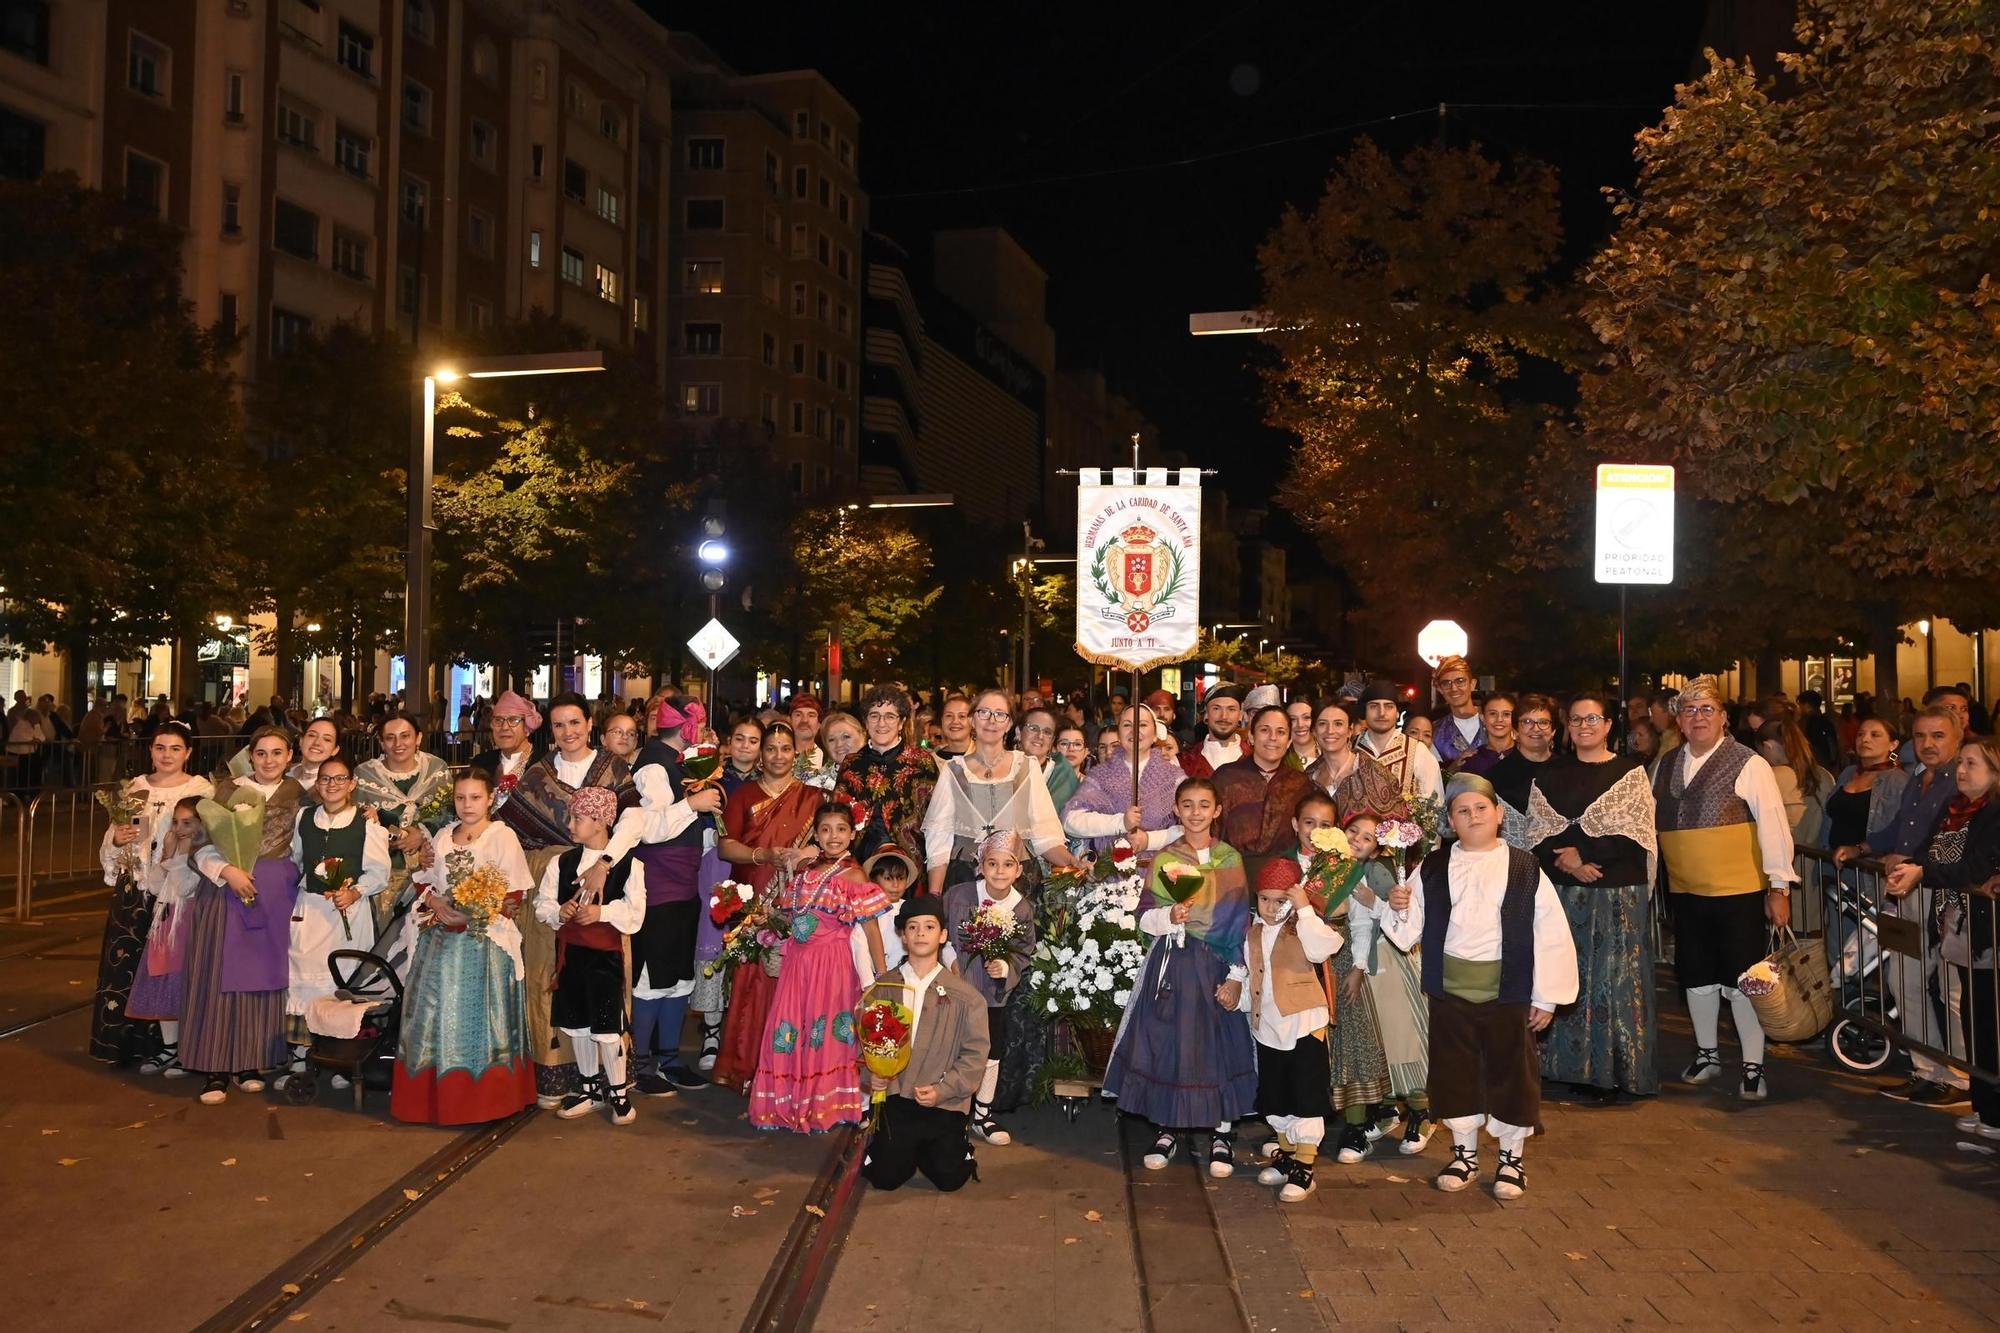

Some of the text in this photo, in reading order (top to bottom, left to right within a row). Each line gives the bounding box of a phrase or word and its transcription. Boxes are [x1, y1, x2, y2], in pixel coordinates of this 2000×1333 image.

[1085, 496, 1193, 549] HERMANAS DE LA CARIDAD DE SANTA ANA
[1604, 552, 1665, 562] PRIORIDAD
[1605, 567, 1664, 576] PEATONAL
[1111, 637, 1133, 648] JUNTO
[1137, 637, 1143, 648] A
